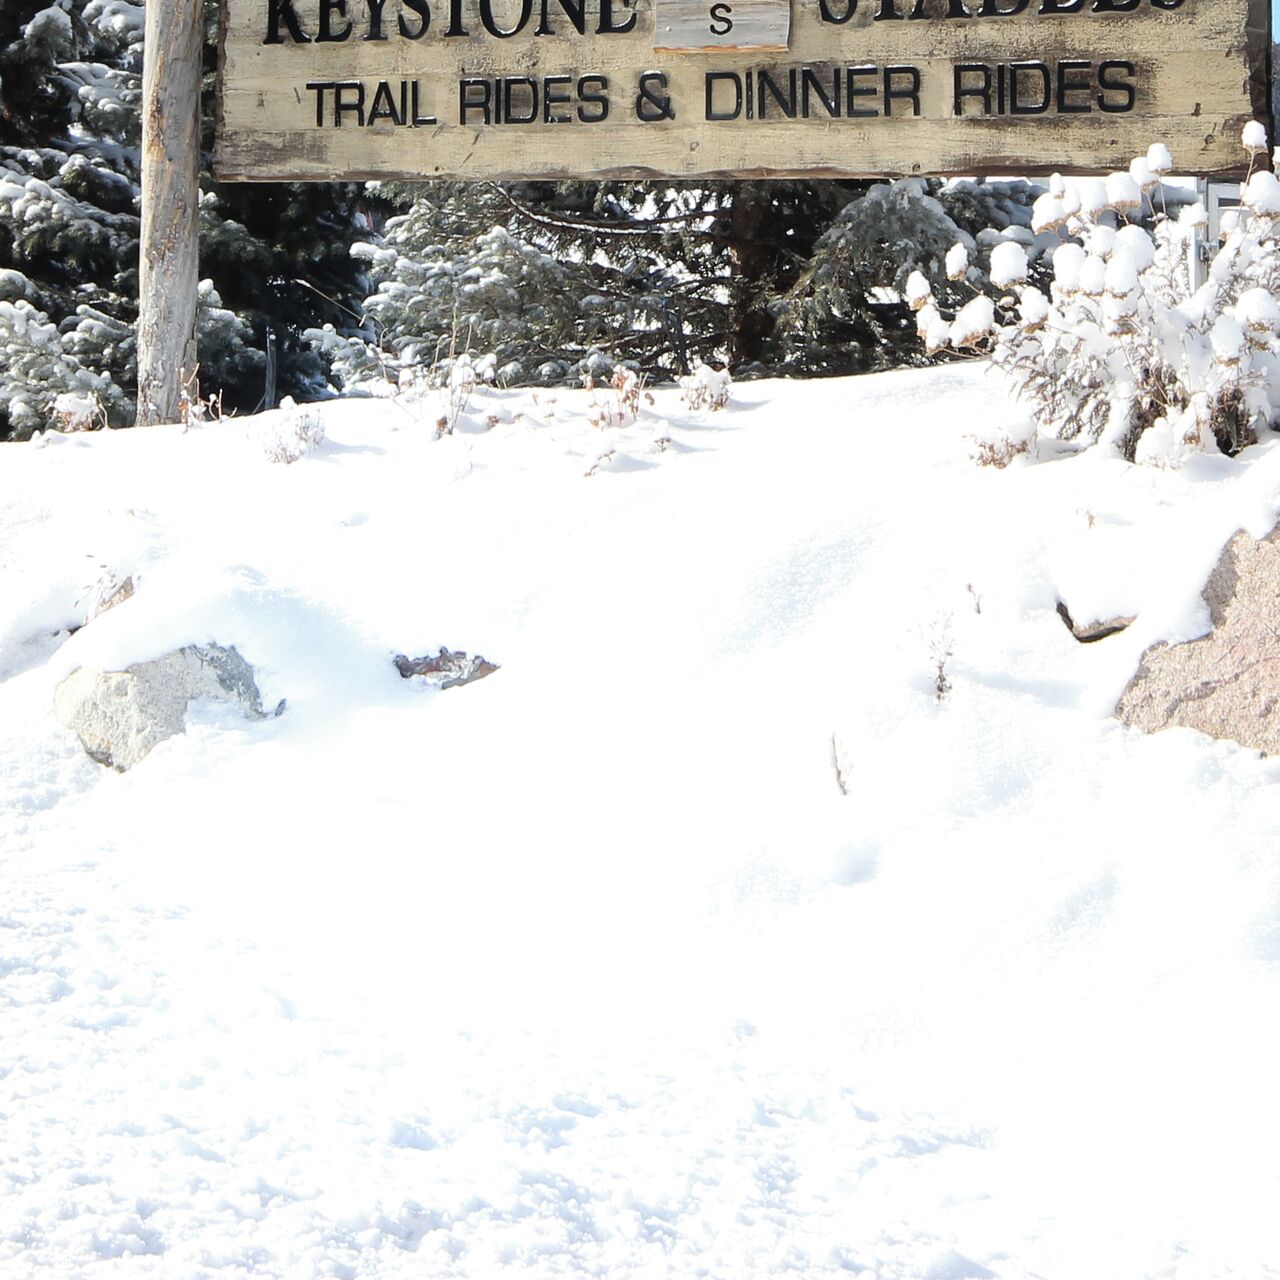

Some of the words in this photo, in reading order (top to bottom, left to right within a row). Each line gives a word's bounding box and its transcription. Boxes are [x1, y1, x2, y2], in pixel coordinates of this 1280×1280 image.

[710, 3, 733, 35] S
[306, 80, 437, 127] TRAIL
[460, 74, 610, 125] RIDES
[634, 69, 674, 121] &
[705, 64, 921, 119] DINNER
[954, 59, 1138, 116] RIDES
